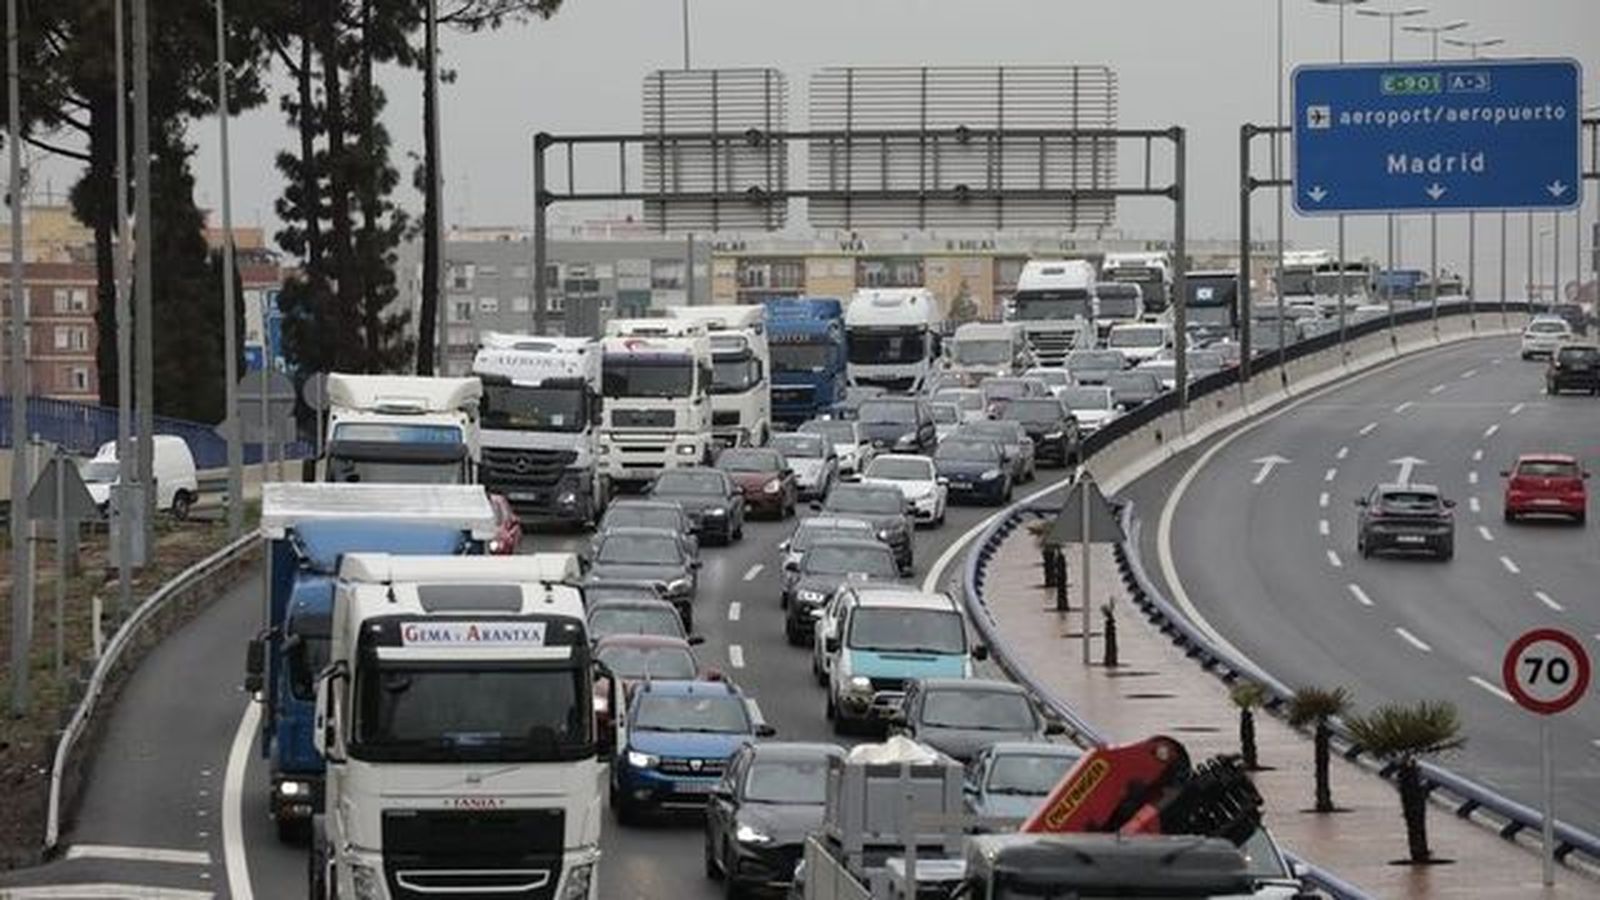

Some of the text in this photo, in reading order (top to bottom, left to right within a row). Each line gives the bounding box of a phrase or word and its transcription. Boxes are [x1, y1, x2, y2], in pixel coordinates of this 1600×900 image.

[1384, 76, 1487, 91] E-901 A-3
[1339, 104, 1566, 127] aeroport/aeropuerto
[1387, 152, 1485, 174] Madrid
[405, 624, 450, 642] GEMA
[467, 624, 541, 642] ARANTXA
[1524, 657, 1570, 685] 70
